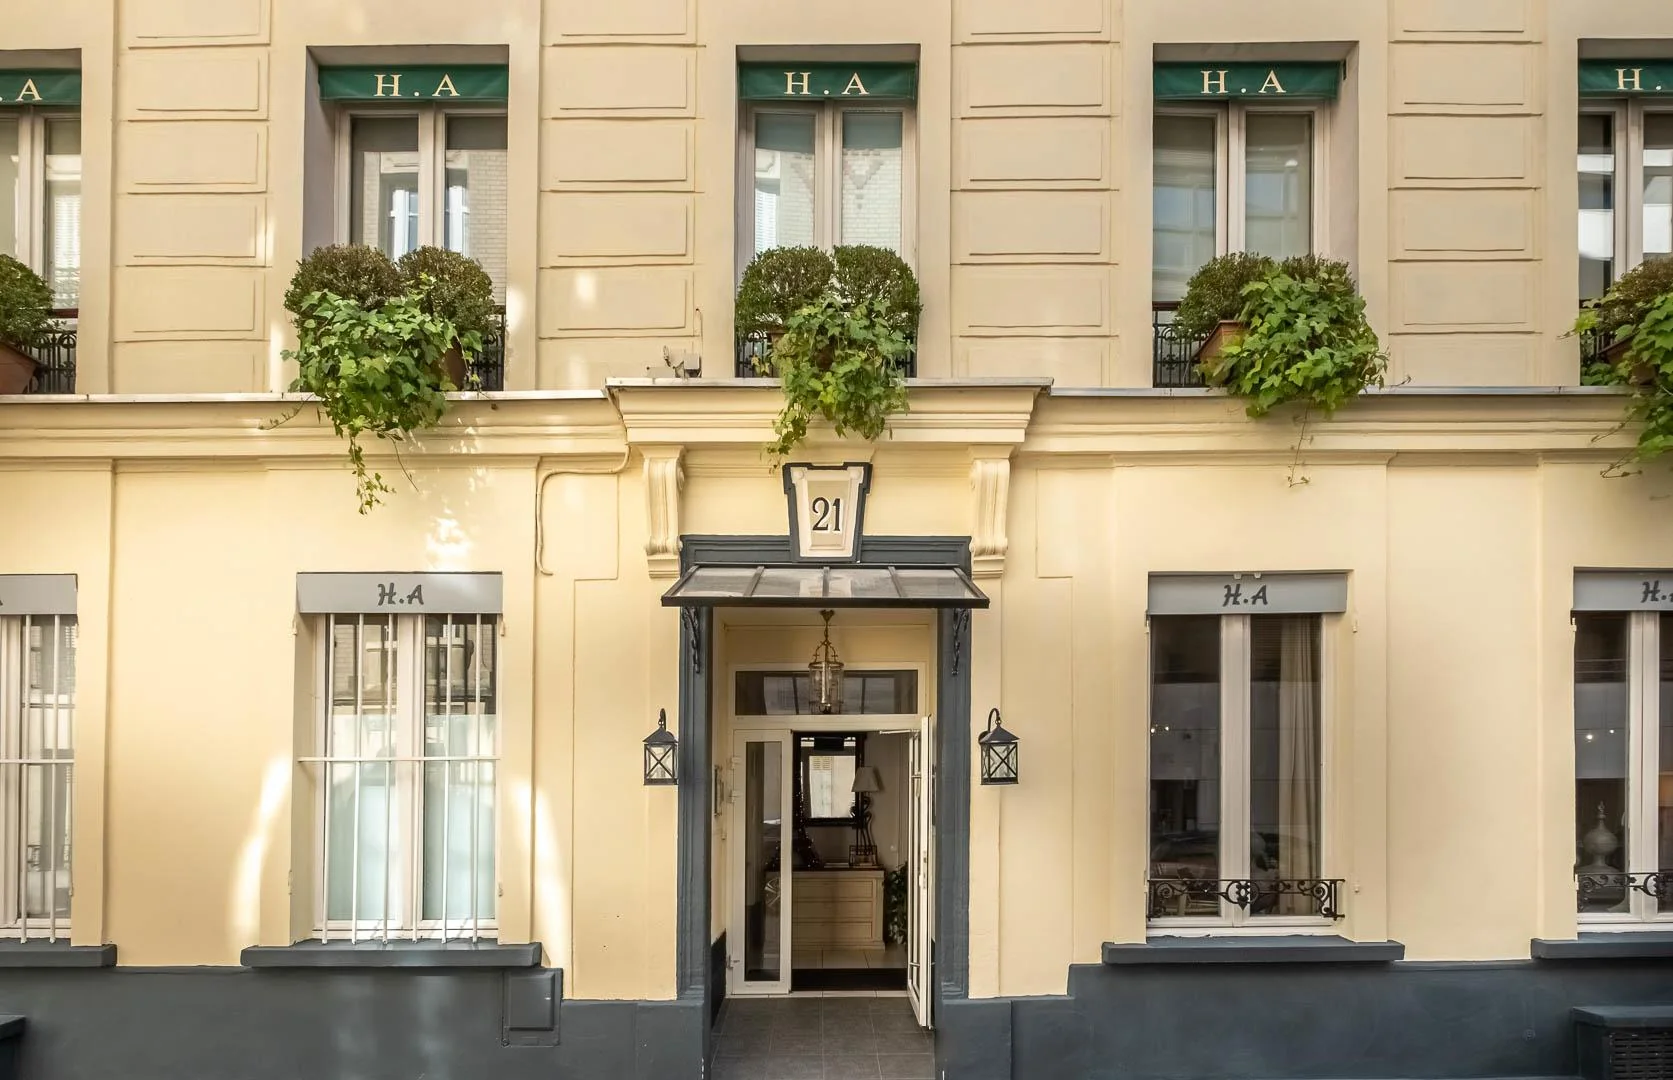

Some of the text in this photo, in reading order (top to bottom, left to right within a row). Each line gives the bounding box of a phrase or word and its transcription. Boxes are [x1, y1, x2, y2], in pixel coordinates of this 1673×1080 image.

[812, 496, 841, 532] 21
[377, 582, 424, 606] H.A
[1222, 583, 1268, 607] H.A
[1640, 580, 1673, 604] H.
